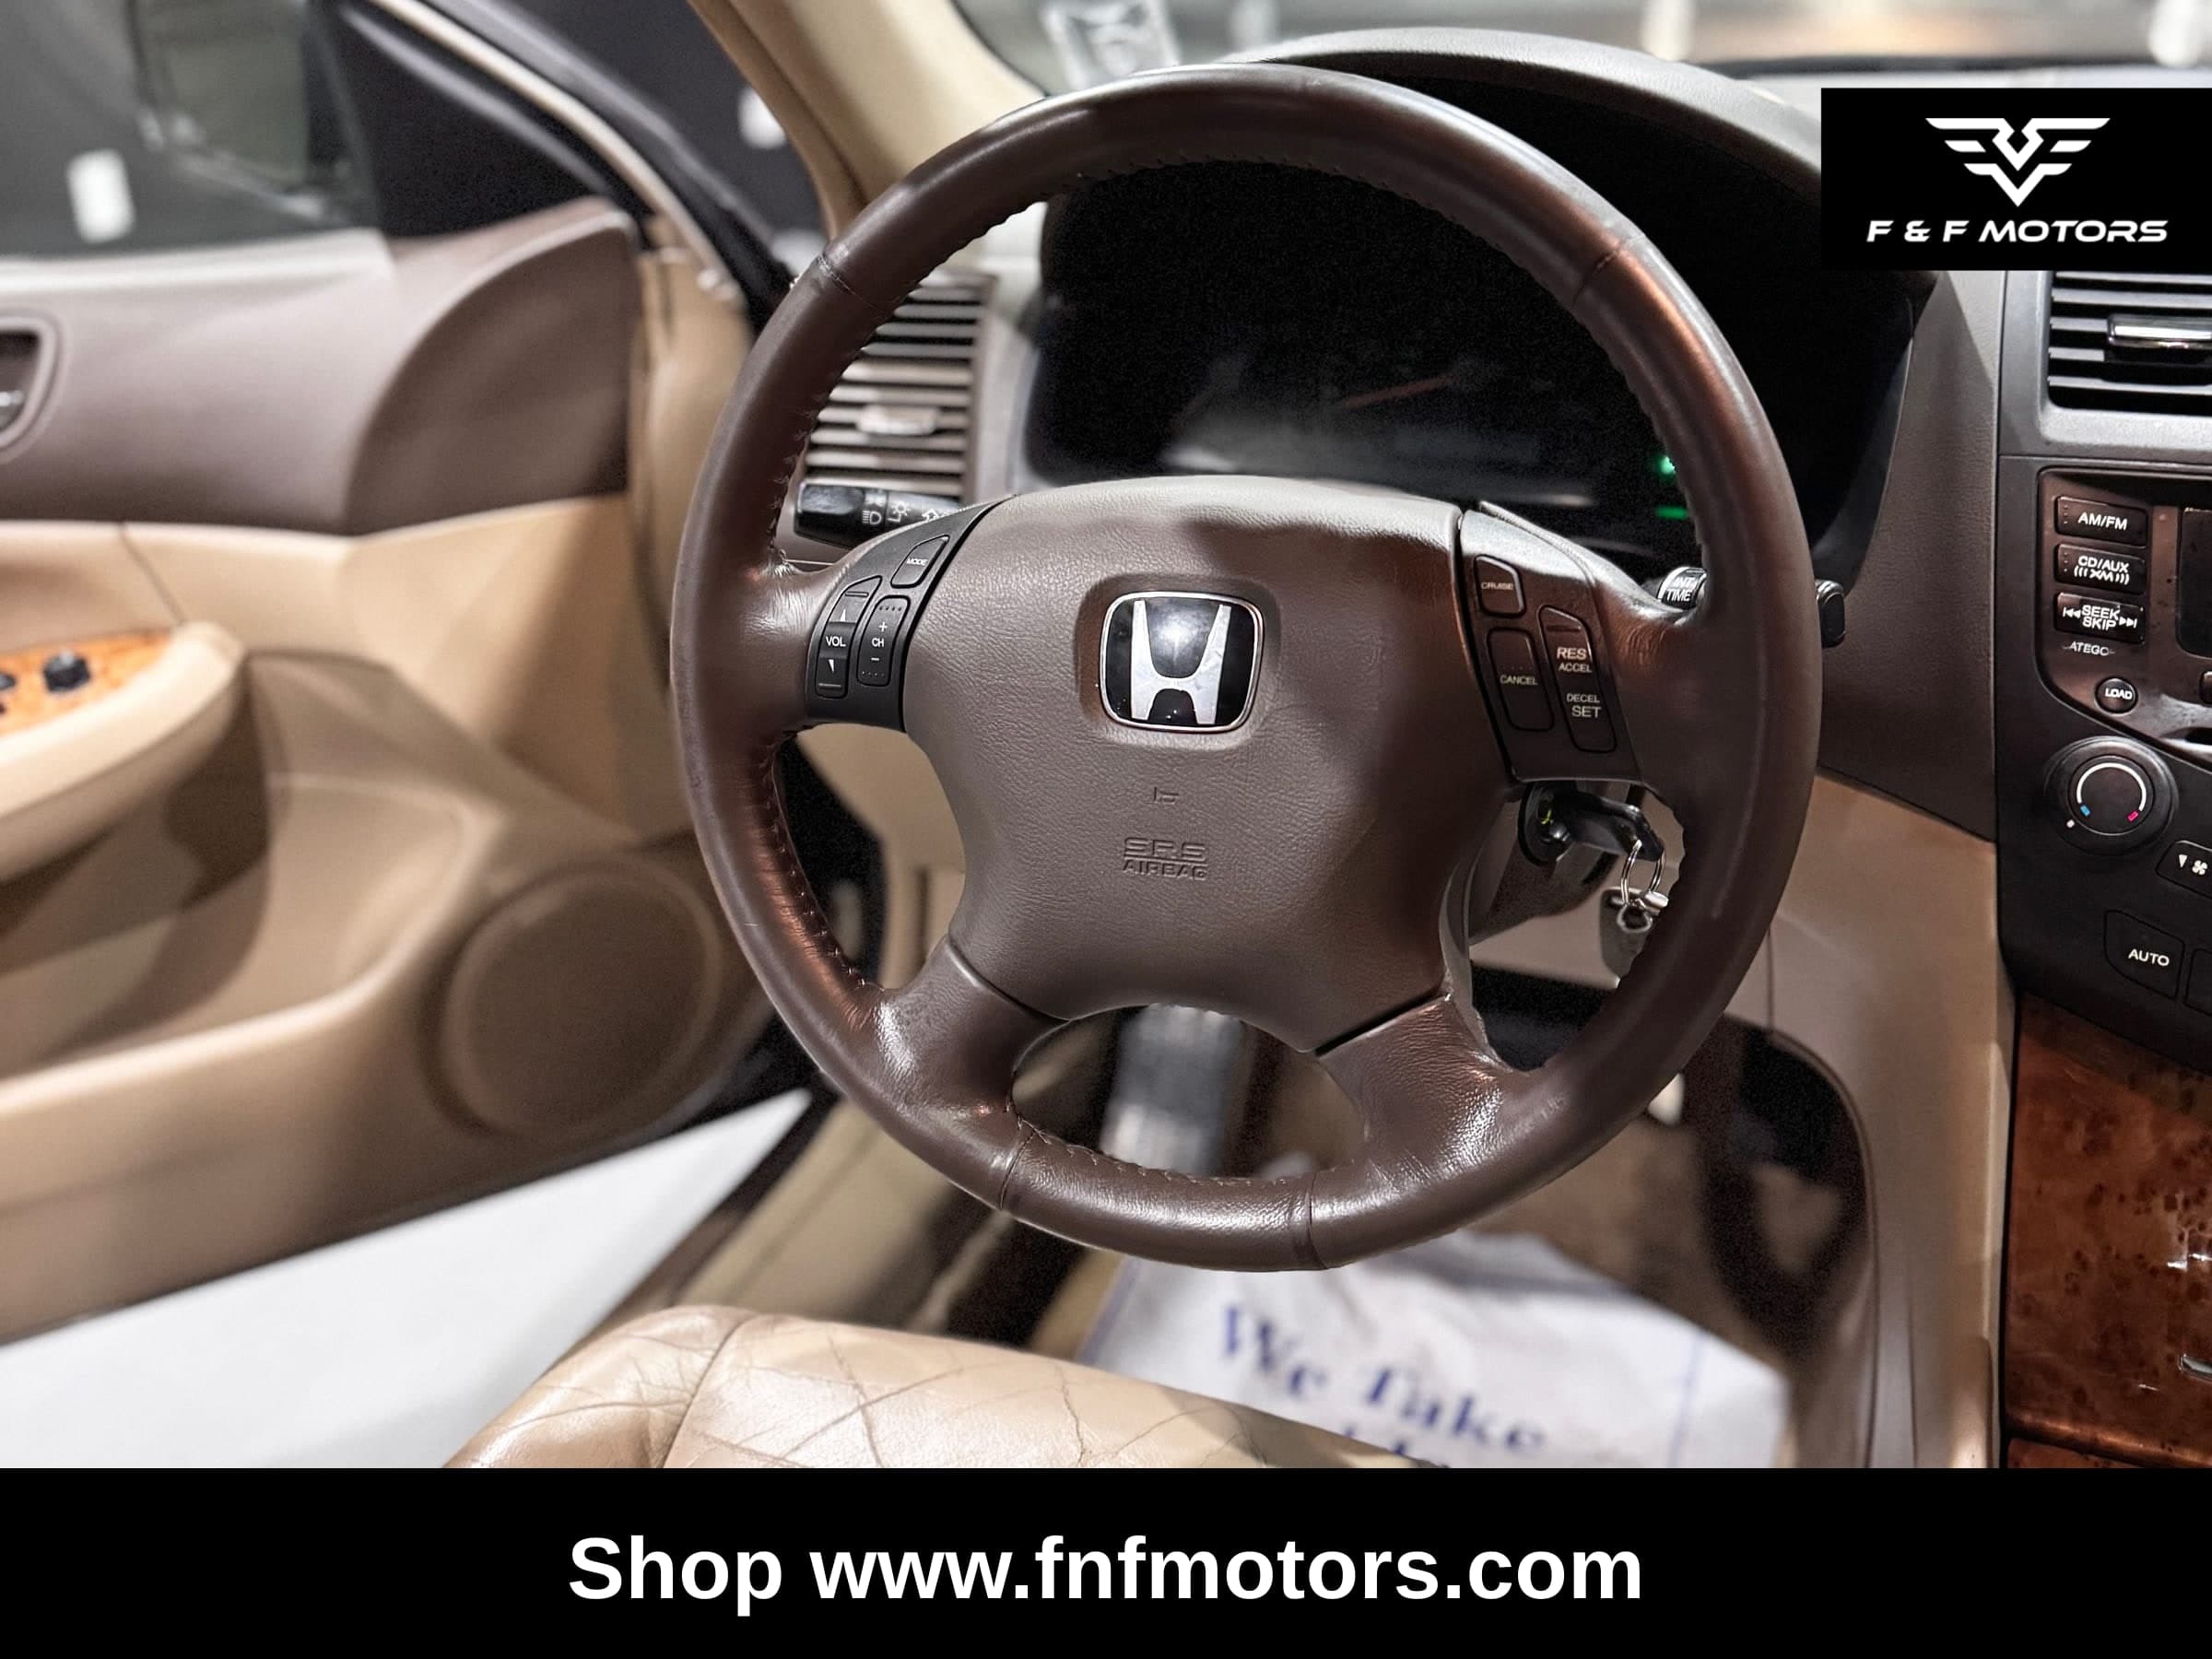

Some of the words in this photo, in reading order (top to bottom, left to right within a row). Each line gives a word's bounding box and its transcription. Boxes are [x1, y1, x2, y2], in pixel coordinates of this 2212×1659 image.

[2077, 512, 2128, 530] AM/FM
[906, 558, 928, 567] MODE
[2077, 555, 2129, 573] CD/AUX
[1480, 581, 1513, 591] CRUISE
[1666, 589, 1693, 601] TIME
[2081, 604, 2121, 620] SEEK
[2082, 616, 2117, 630] SKIP
[825, 636, 846, 647] VOL
[871, 637, 885, 647] CH
[1557, 647, 1587, 660] RES
[1558, 663, 1593, 673] ACCEL
[1500, 675, 1537, 686] CANCEL
[1566, 693, 1600, 703] DECEL
[2104, 688, 2133, 700] LOAD
[1571, 705, 1602, 718] SET
[1124, 837, 1206, 863] SRS
[1124, 859, 1208, 881] AIRBAG
[2127, 948, 2170, 967] AUTO
